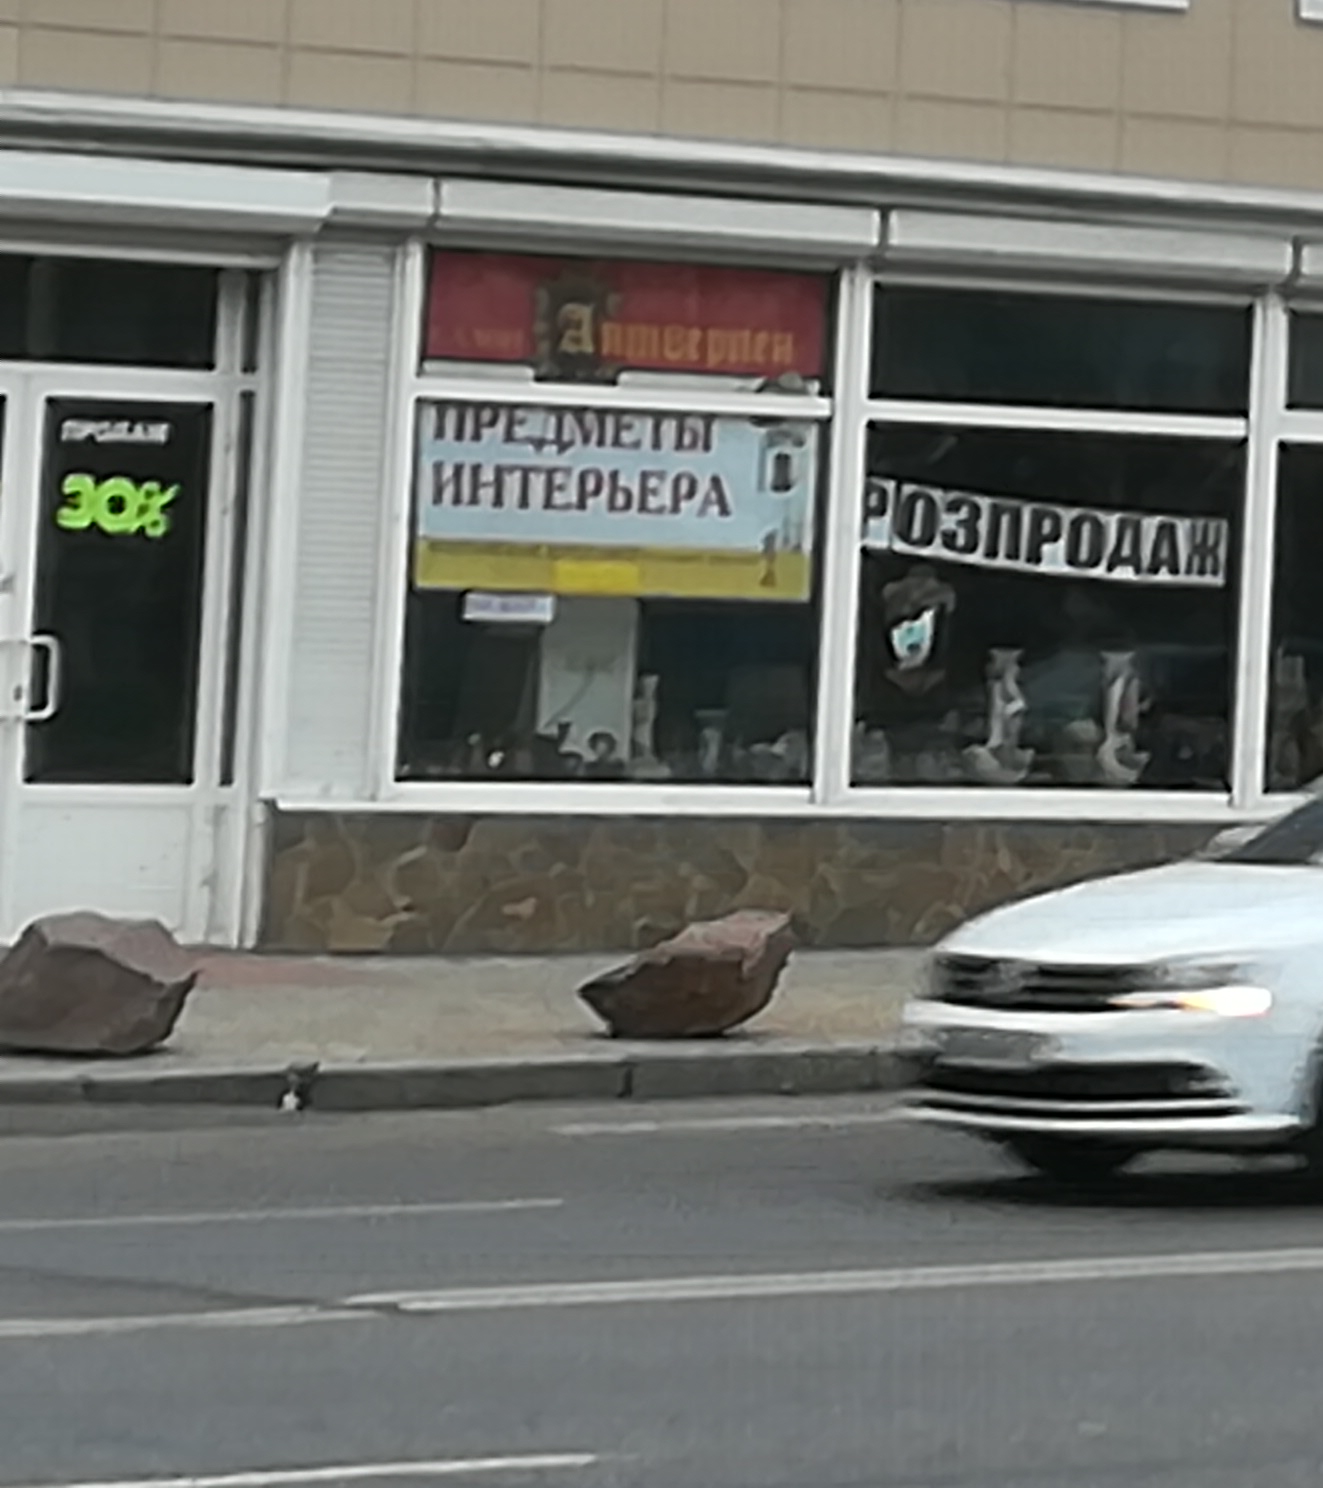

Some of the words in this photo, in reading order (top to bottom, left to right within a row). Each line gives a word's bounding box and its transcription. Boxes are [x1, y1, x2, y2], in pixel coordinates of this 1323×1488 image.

[432, 402, 717, 455] ПРЕДМЕТЫ
[56, 473, 181, 538] 30%
[432, 461, 732, 518] ИНТЕРЬЕРА
[862, 481, 1221, 577] РОЗПРОДАЖ
